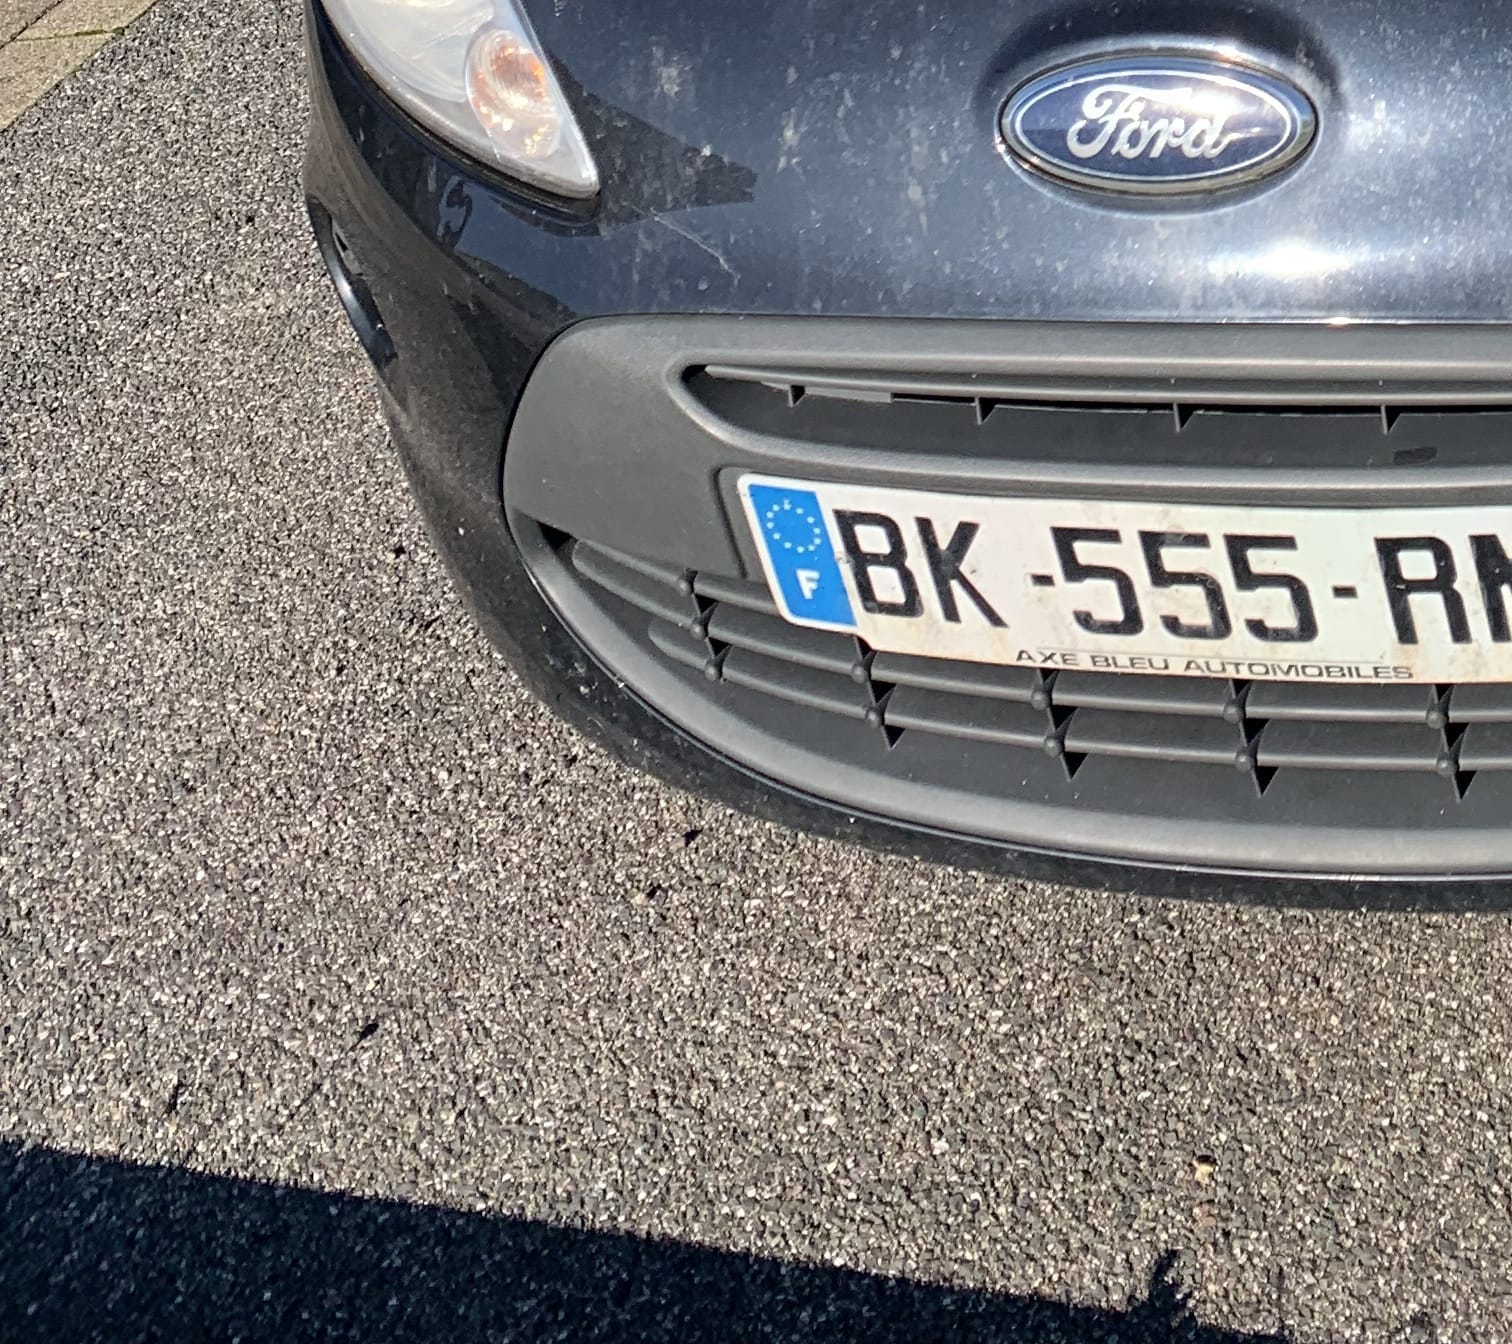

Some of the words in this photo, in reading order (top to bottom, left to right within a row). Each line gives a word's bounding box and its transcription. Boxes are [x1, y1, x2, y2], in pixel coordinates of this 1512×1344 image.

[1067, 84, 1260, 157] Ford
[796, 568, 820, 599] F
[1016, 649, 1079, 666] AXE
[1090, 654, 1169, 671] BLEU
[1183, 659, 1413, 679] AUTOMOBILES
